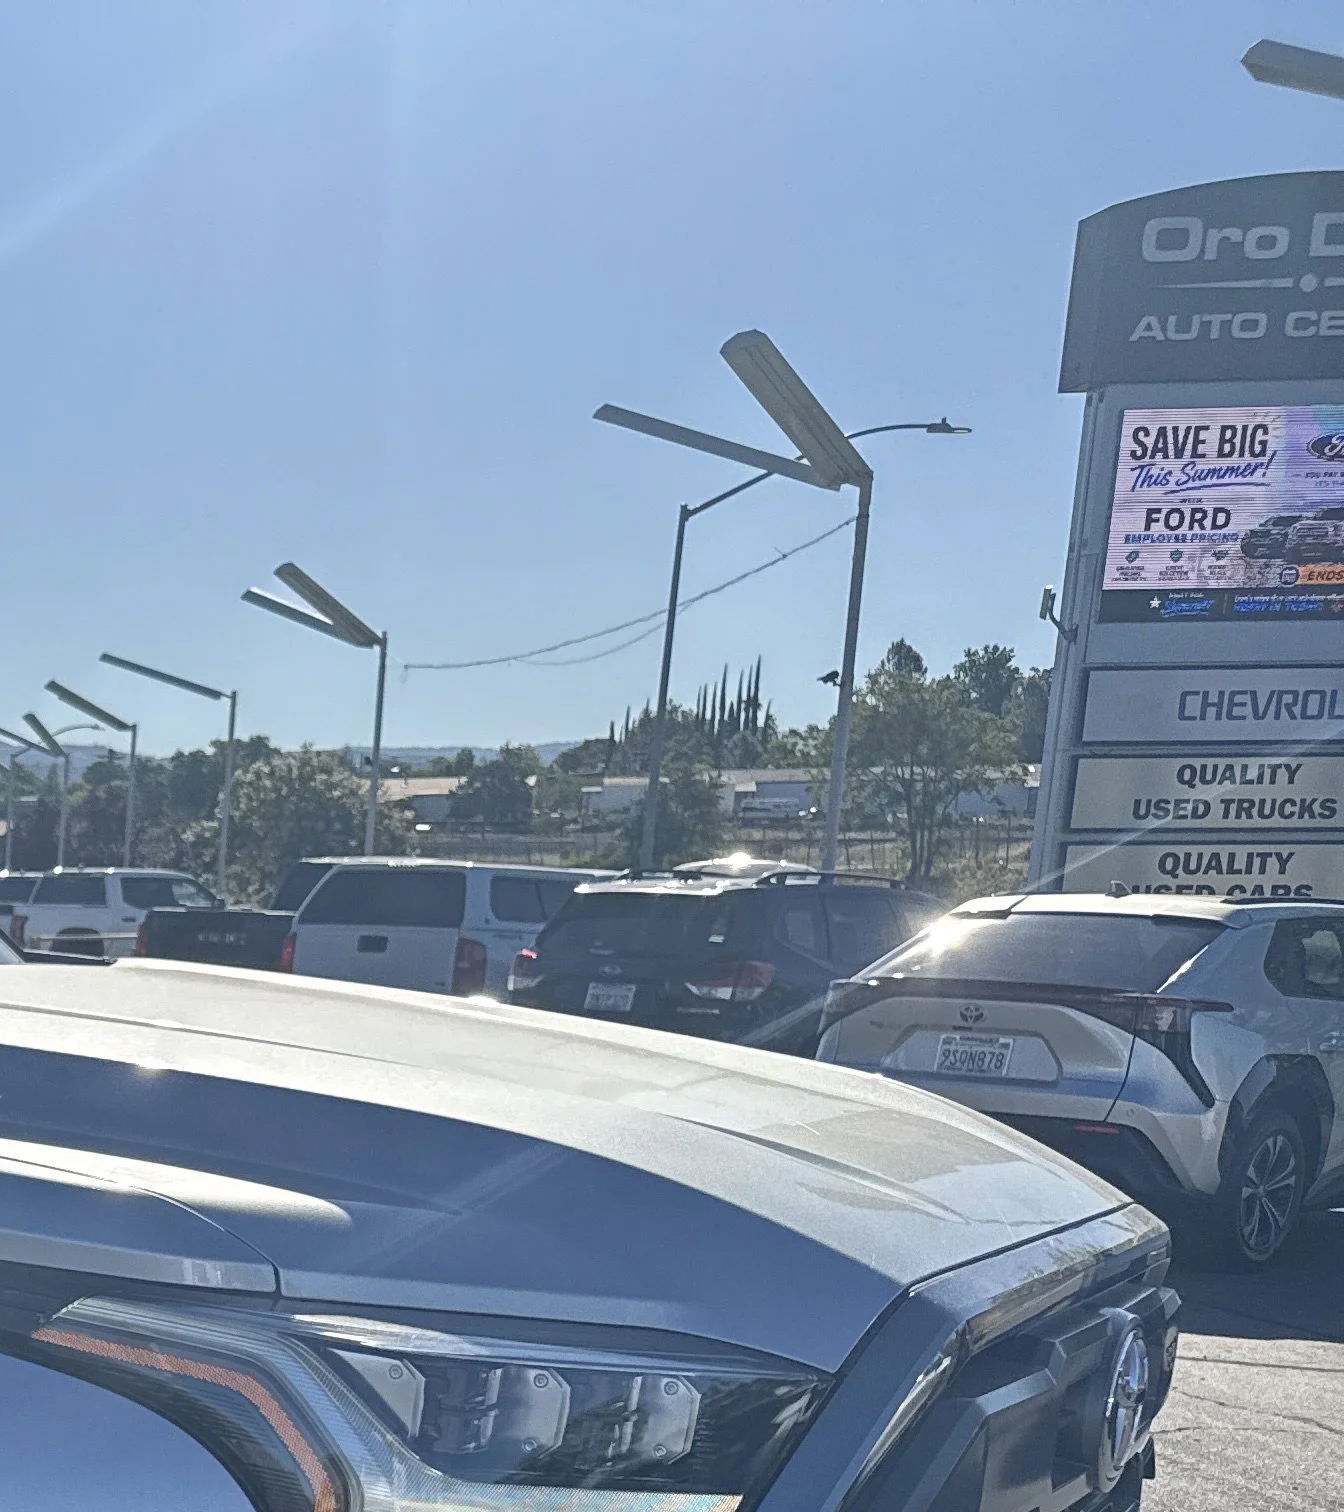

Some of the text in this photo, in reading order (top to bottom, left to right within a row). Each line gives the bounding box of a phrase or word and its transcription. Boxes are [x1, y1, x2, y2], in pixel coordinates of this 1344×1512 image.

[1141, 215, 1290, 262] Oro
[1129, 311, 1268, 341] AUTO
[1129, 423, 1269, 461] SAVE BIG
[1130, 450, 1277, 492] This Summer!
[1144, 507, 1232, 531] FORD
[1124, 532, 1240, 544] EMPLOYEE PRICING
[1178, 689, 1344, 721] CHEVROL
[1176, 763, 1303, 789] QUALITY
[1132, 798, 1337, 821] USED TRUCKS
[1158, 852, 1295, 878] QUALITY
